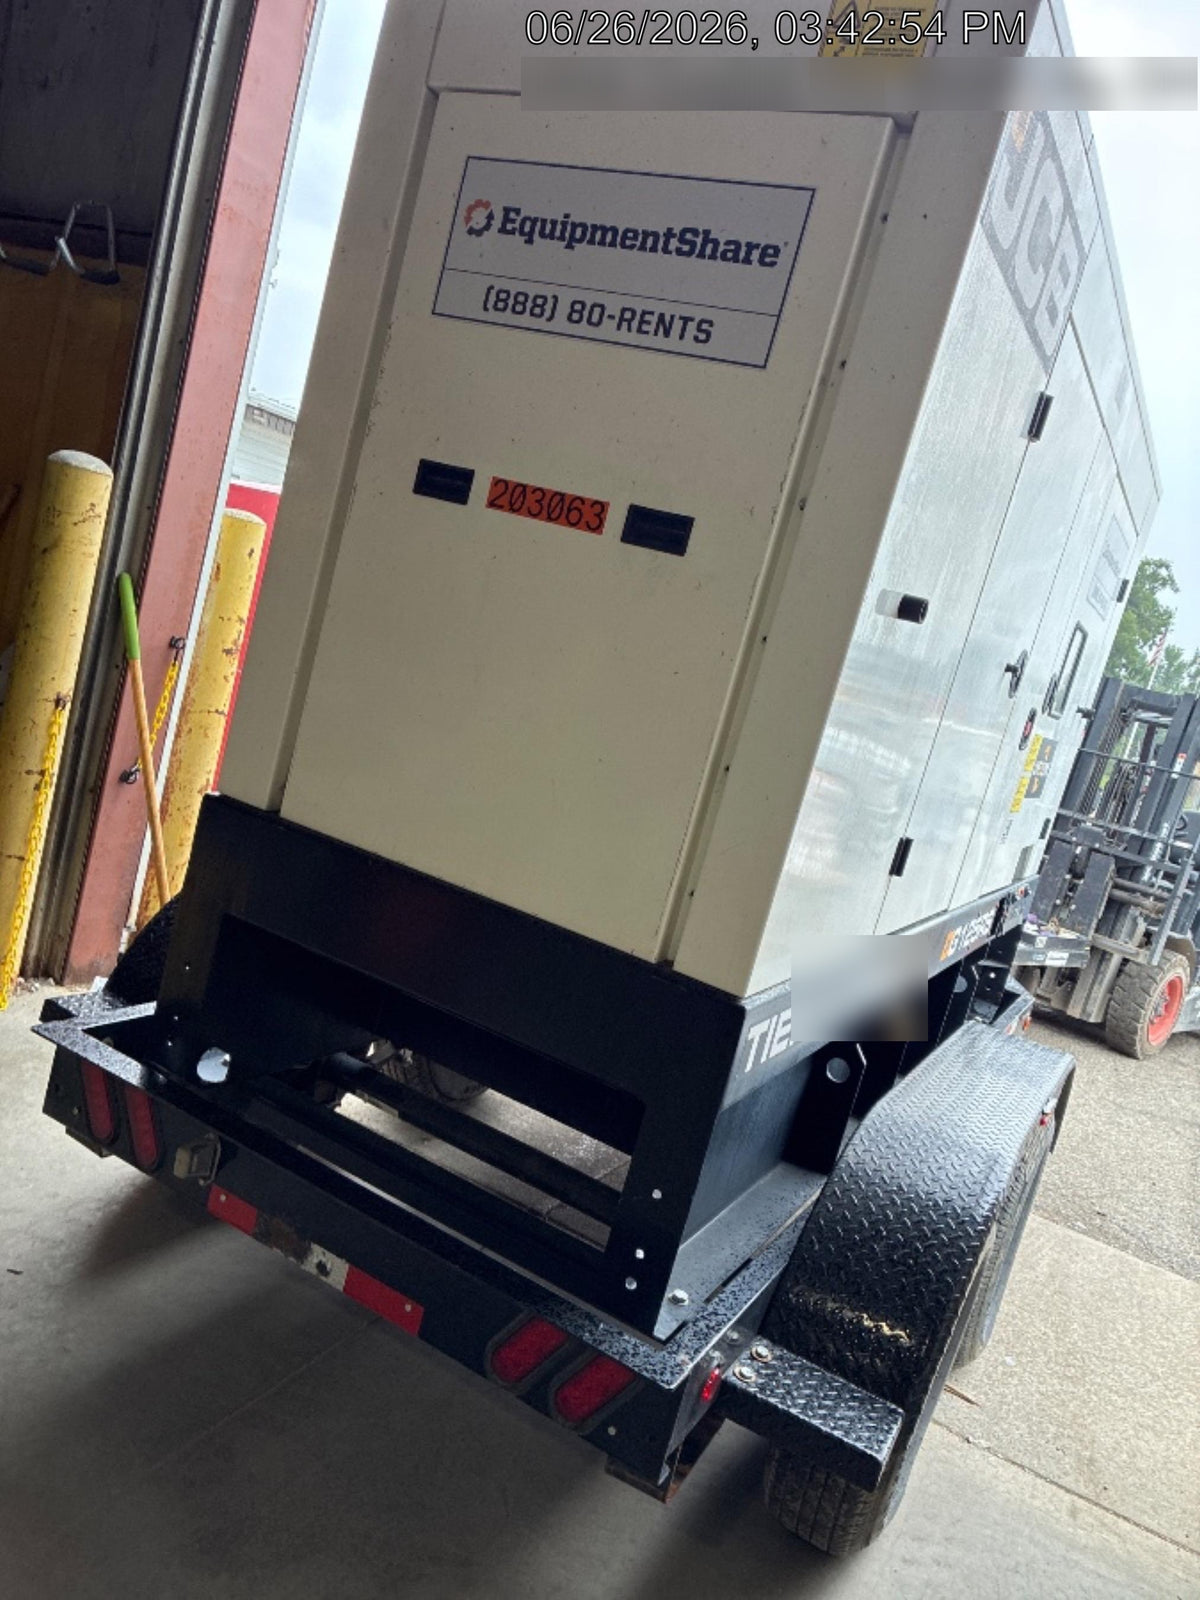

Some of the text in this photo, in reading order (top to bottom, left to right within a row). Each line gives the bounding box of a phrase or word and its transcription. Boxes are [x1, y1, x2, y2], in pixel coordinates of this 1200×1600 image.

[497, 205, 782, 268] EquipmentShare
[986, 118, 1084, 360] JCB
[482, 284, 714, 344] (888) 80-RENTS
[488, 478, 608, 531] 203063
[744, 1007, 794, 1074] TIE
